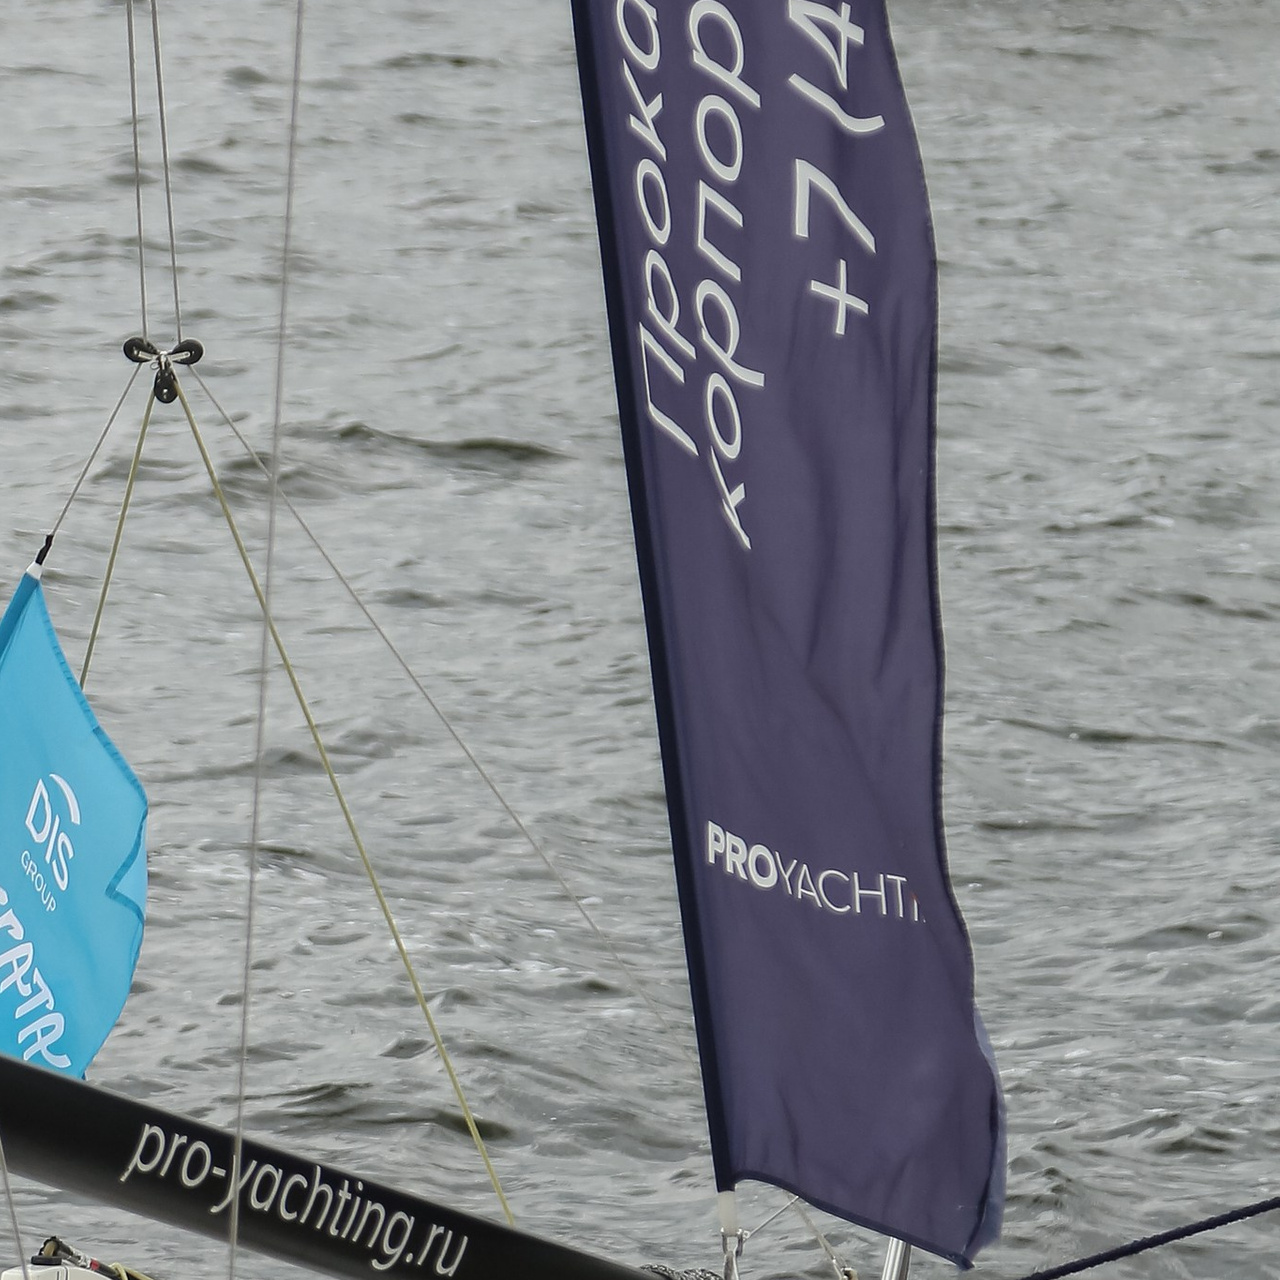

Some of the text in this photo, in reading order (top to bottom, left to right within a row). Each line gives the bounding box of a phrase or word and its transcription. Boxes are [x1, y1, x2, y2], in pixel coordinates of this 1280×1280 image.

[793, 157, 877, 336] +7
[20, 849, 58, 913] GROUP
[24, 777, 75, 893] DIS
[120, 1122, 469, 1278] pro-yachting.ru
